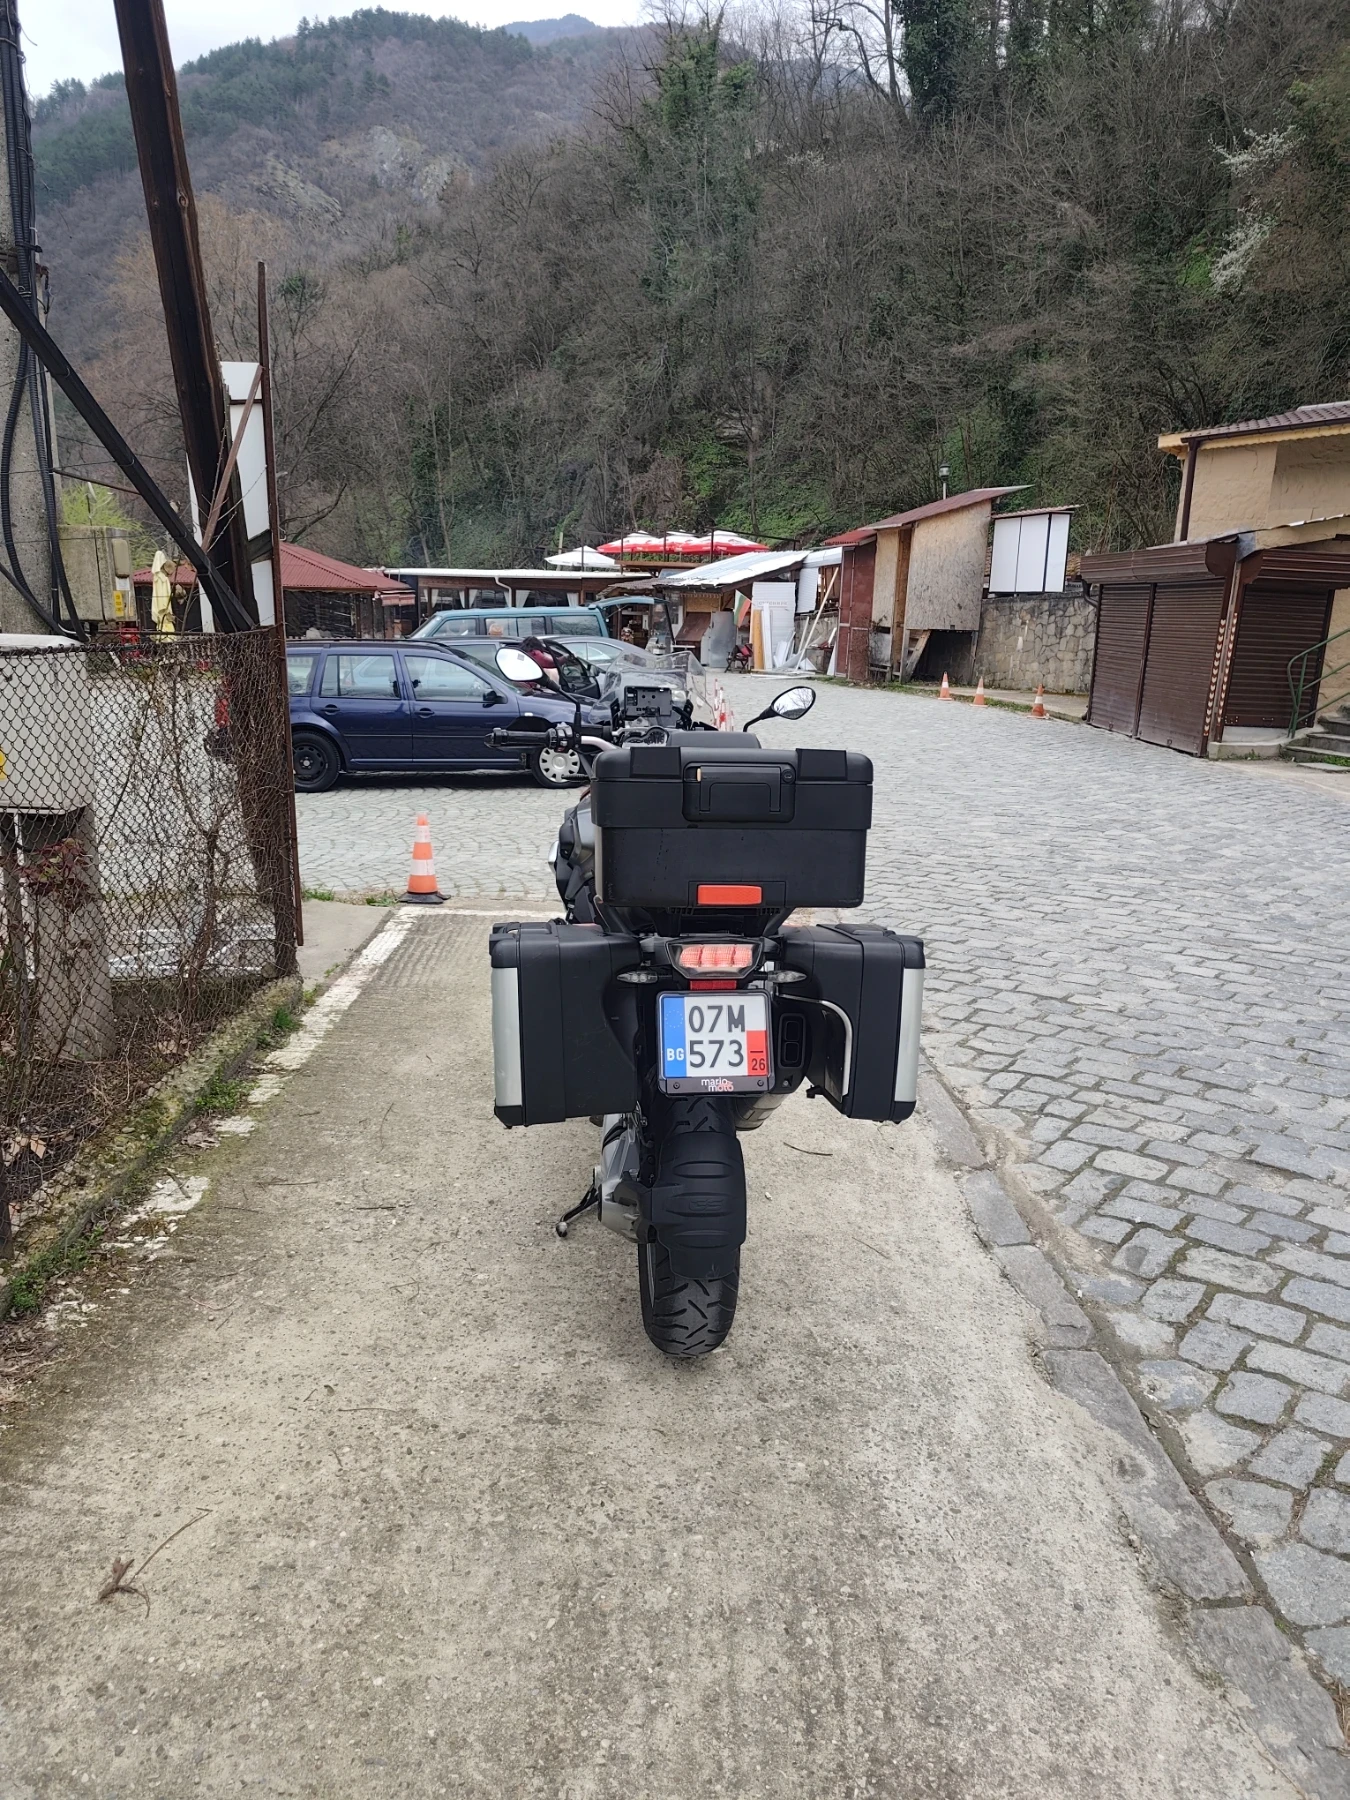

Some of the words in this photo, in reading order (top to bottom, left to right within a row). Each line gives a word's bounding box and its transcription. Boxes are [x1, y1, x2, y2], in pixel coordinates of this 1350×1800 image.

[688, 1004, 746, 1033] 07M
[666, 1047, 685, 1061] BG
[689, 1039, 744, 1068] 573
[751, 1058, 766, 1071] 26
[701, 1077, 728, 1086] mario
[708, 1084, 734, 1092] moto
